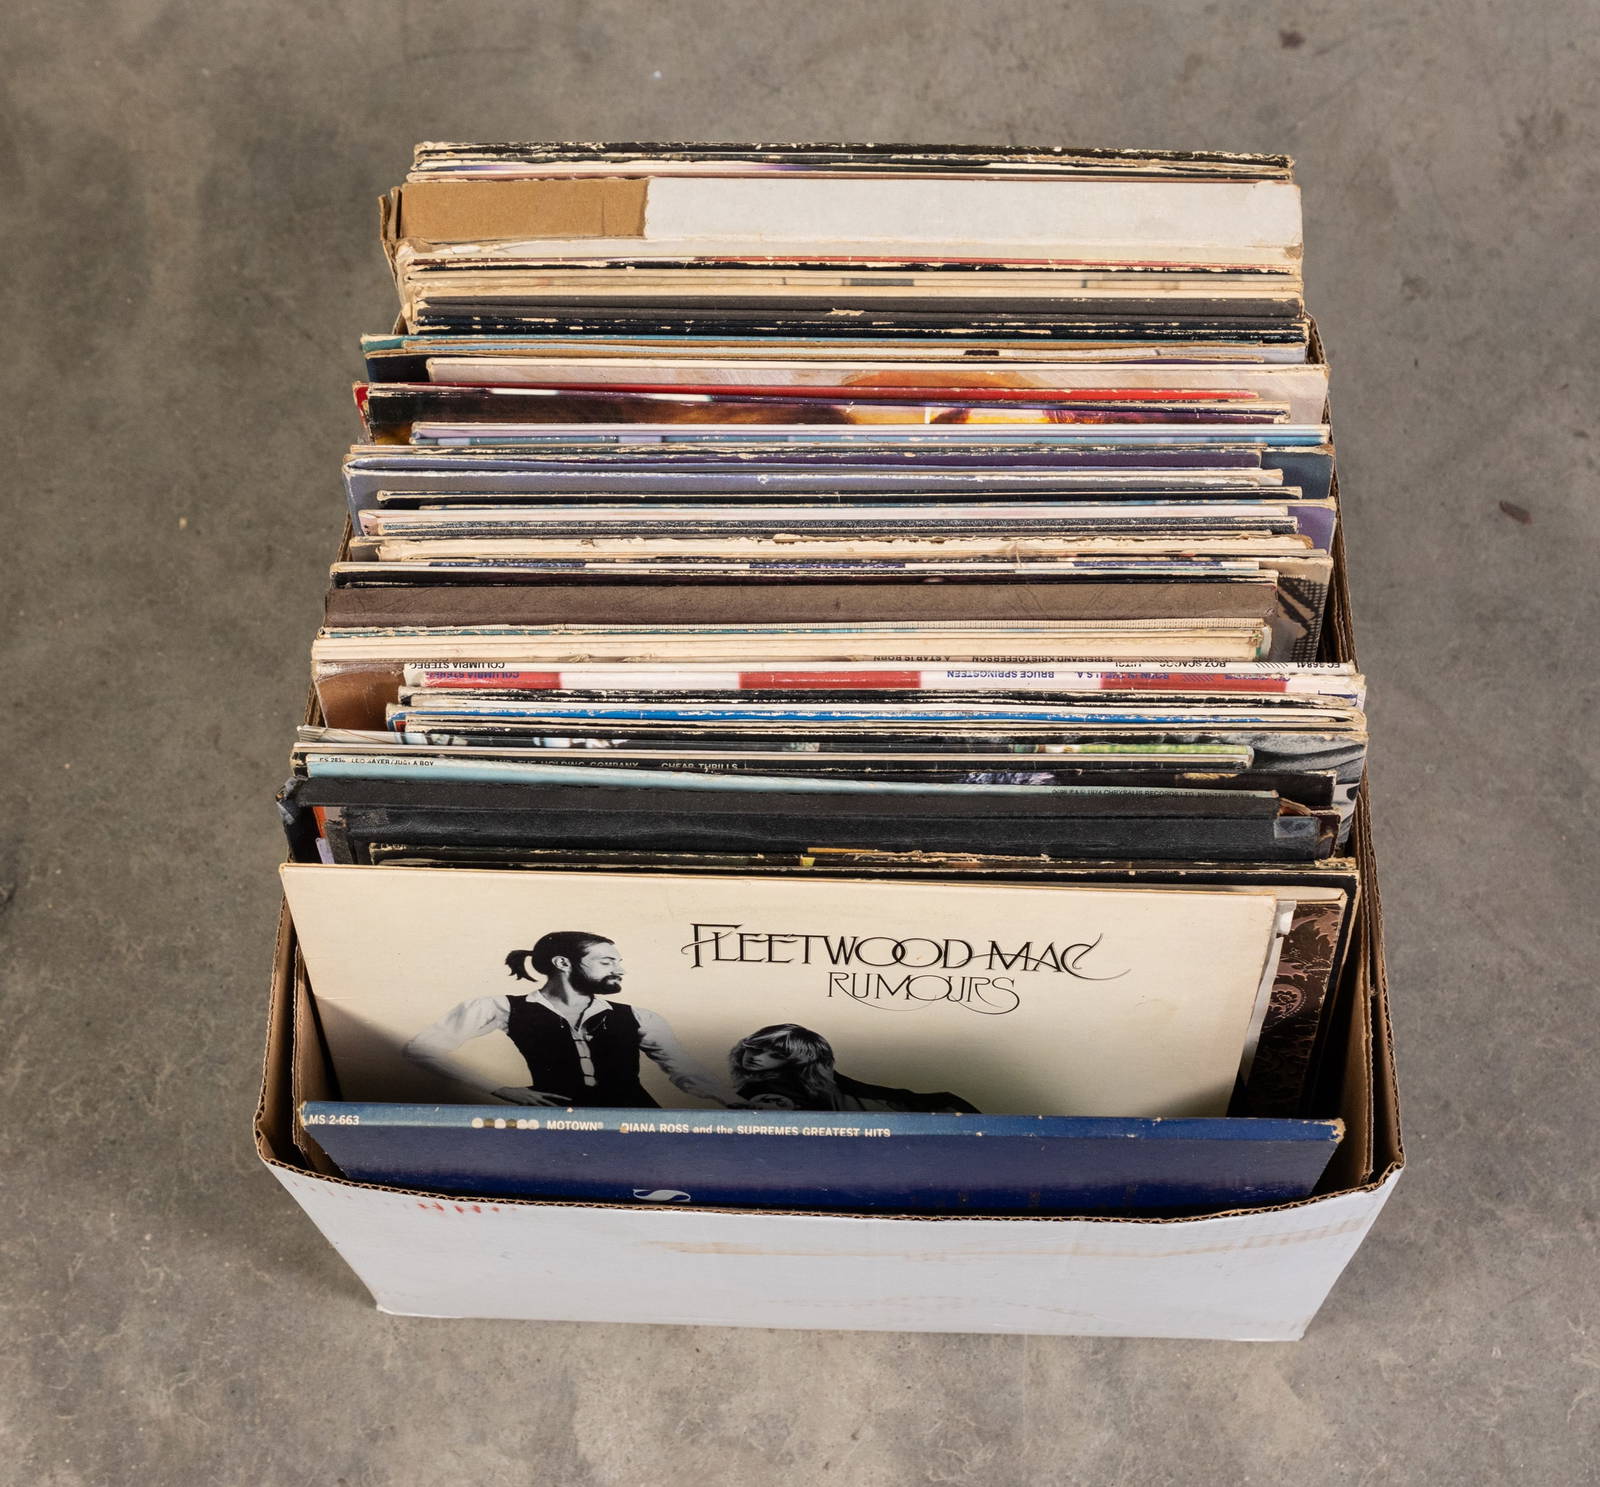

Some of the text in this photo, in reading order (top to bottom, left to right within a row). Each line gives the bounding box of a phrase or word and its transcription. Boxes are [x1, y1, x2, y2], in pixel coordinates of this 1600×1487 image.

[468, 671, 520, 679] COLUMBIA
[947, 670, 1055, 679] BRUCE SPRINGSTEEN
[698, 762, 738, 770] THRILLS
[681, 923, 1131, 981] FLEETWOOD MAC
[827, 971, 1020, 1015] RUMOURS
[308, 1114, 360, 1125] MS 2-663
[620, 1122, 892, 1138] DIANA ROSS and the SUPREMES GREATEST HITS
